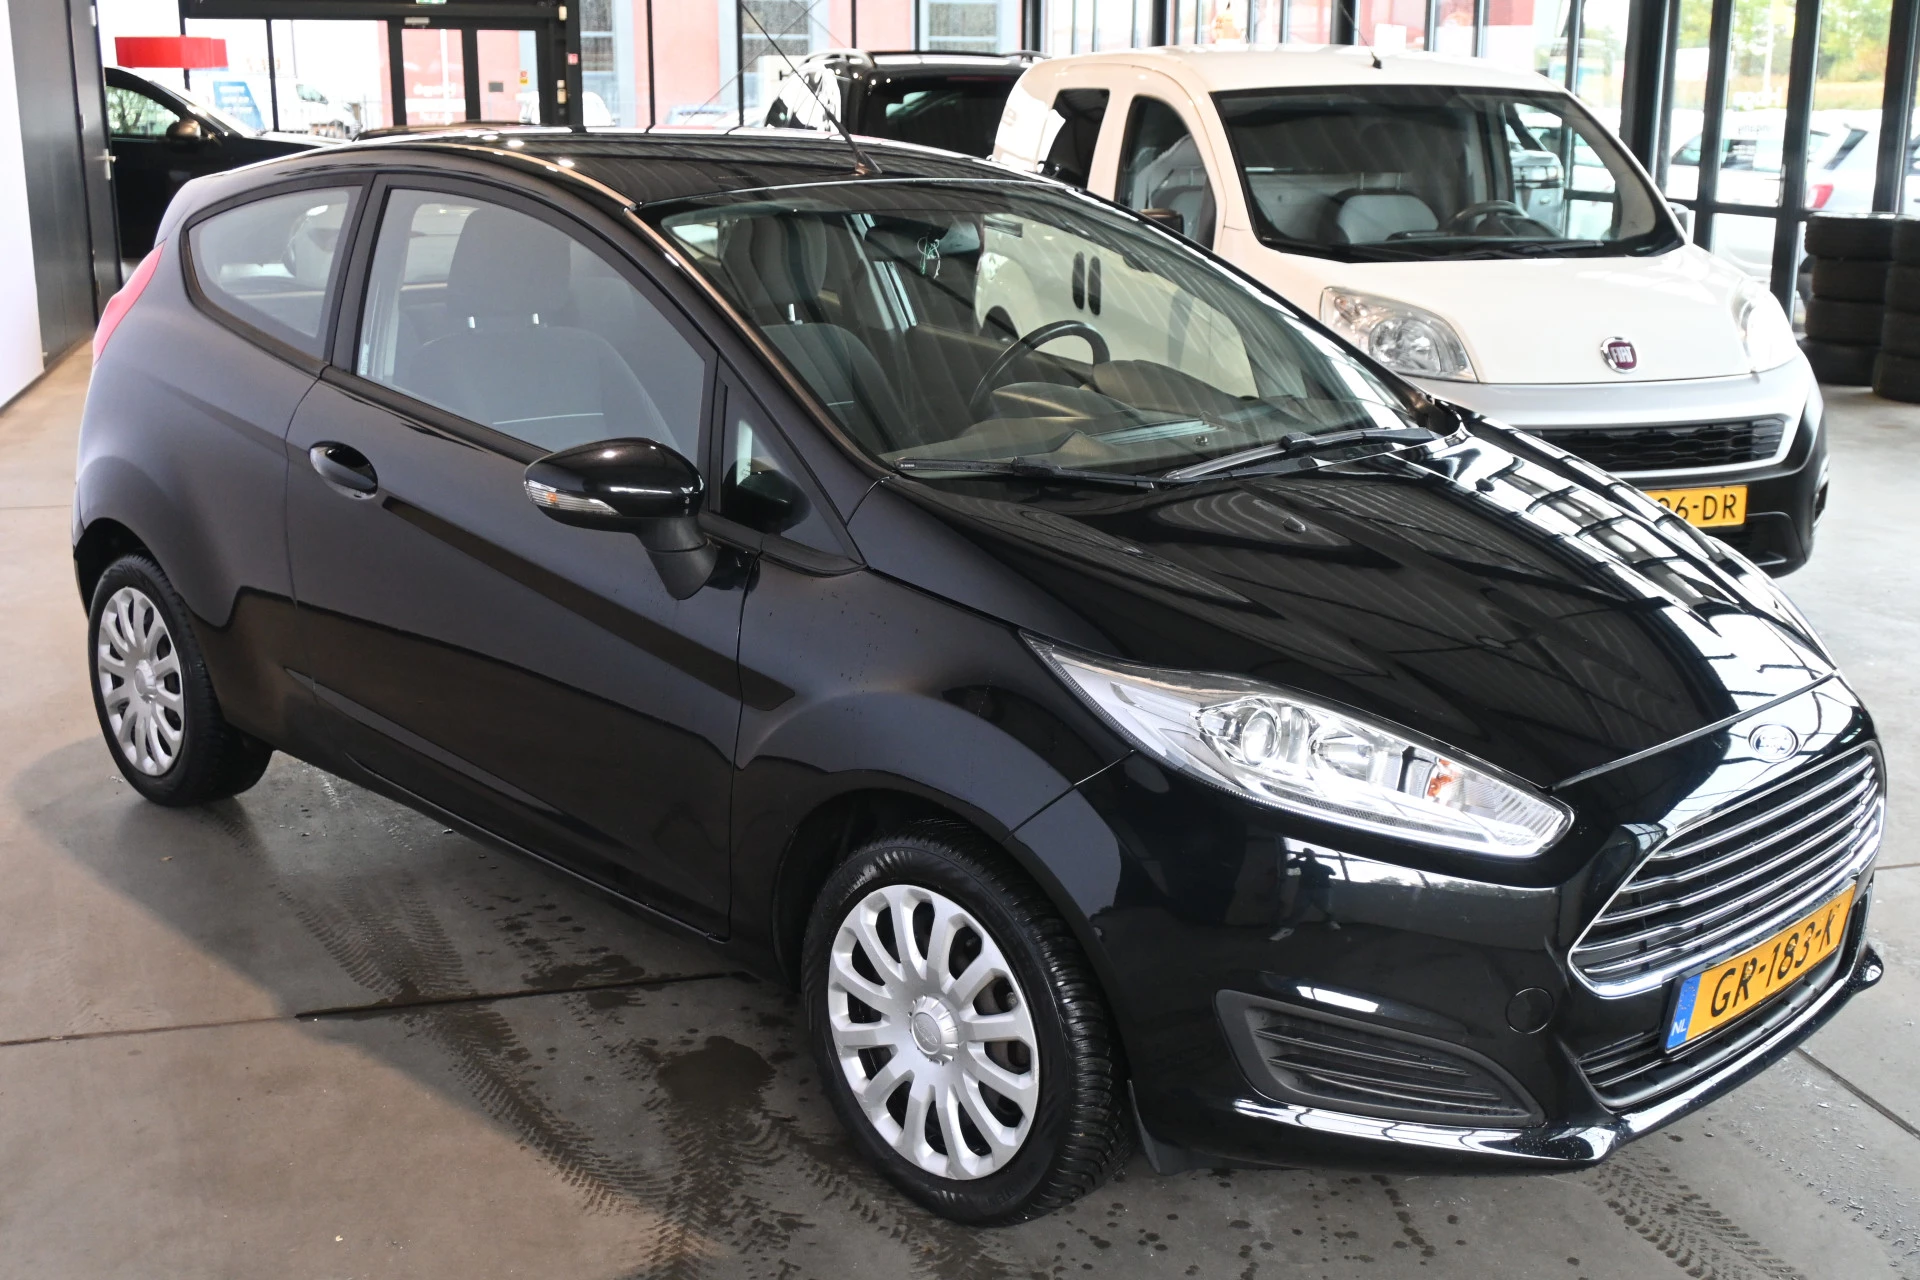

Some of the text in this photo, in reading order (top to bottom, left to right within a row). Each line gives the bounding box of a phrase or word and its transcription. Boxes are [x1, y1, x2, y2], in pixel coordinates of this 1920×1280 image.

[1610, 346, 1634, 363] FIAT
[1711, 903, 1841, 1018] GR-183-K
[1671, 1018, 1687, 1036] NL
